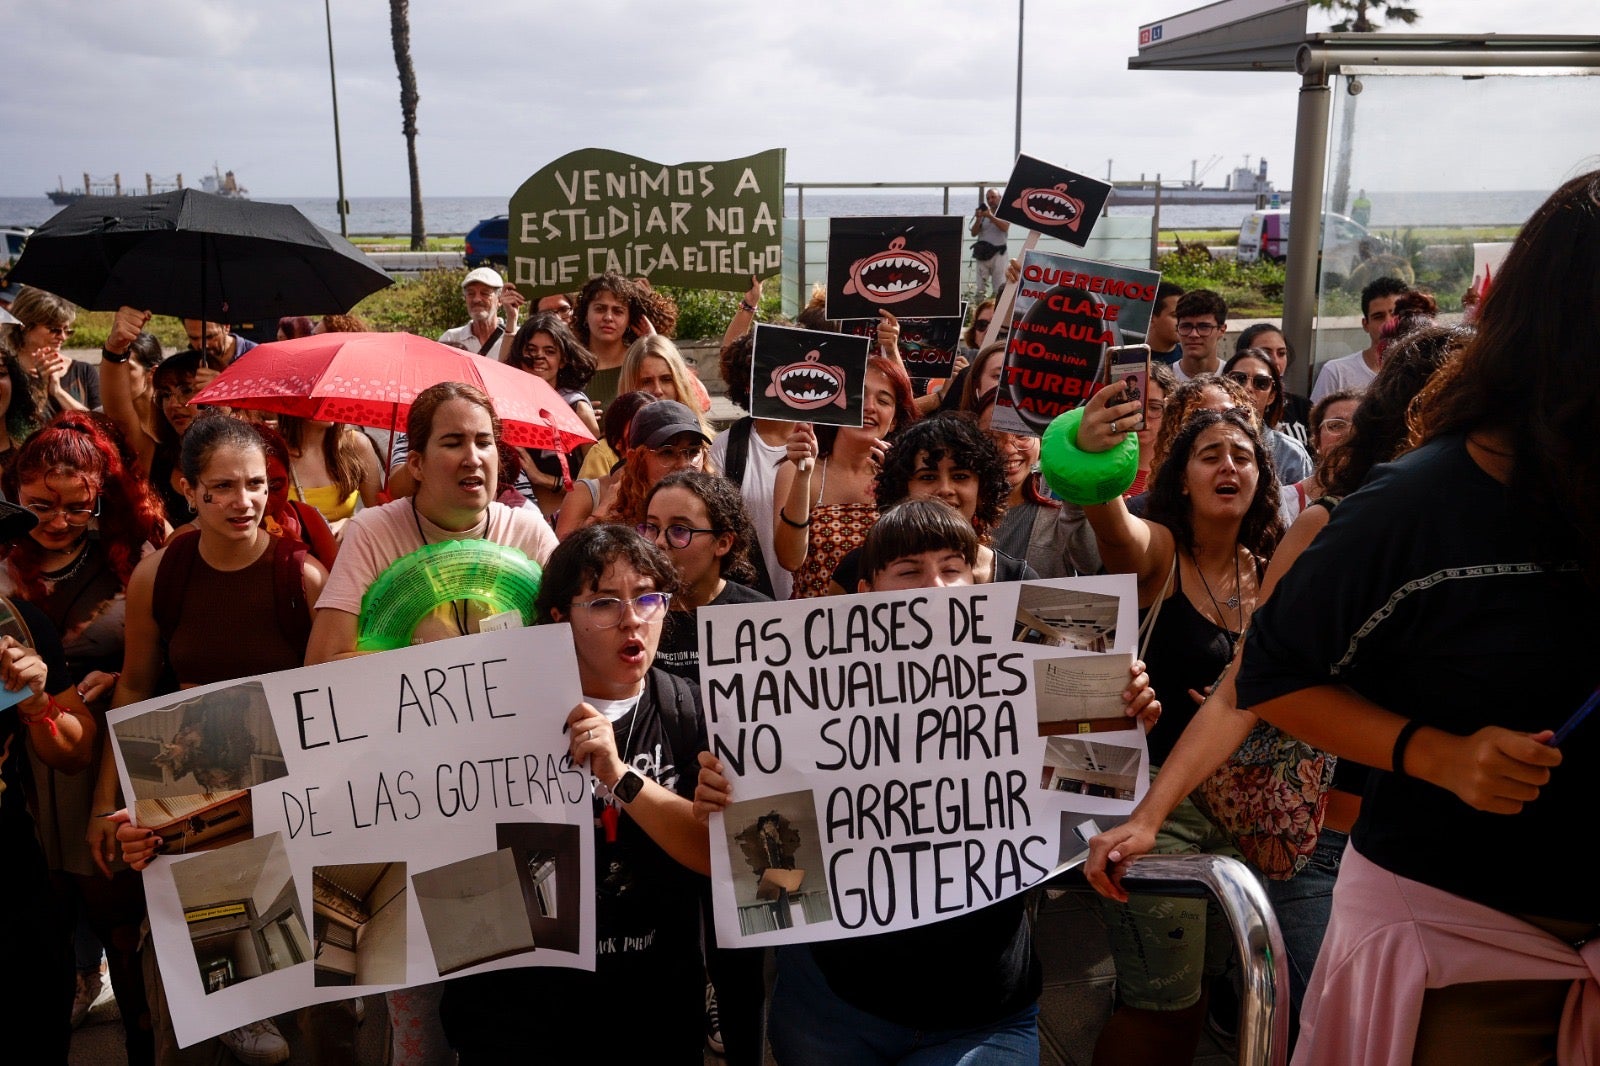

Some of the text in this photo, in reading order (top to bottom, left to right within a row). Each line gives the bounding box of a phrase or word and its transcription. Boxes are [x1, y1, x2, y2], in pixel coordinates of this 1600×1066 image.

[1153, 28, 1161, 39] L1
[734, 168, 760, 197] A
[706, 205, 746, 236] NO
[752, 202, 776, 236] A
[514, 254, 580, 288] QUE
[683, 246, 708, 272] EL
[700, 240, 780, 275] TECHO
[1023, 265, 1157, 302] QUEREMOS
[1021, 288, 1120, 322] DAR CLASE
[1013, 320, 1114, 346] EN UN AULA
[1009, 338, 1088, 367] NO EN UNA
[1005, 366, 1106, 400] TURBI
[705, 595, 992, 666] LAS CLASES DE
[656, 650, 688, 662] NNECTION
[293, 658, 516, 750] EL ARTE
[709, 652, 1027, 722] MANUALIDADES
[714, 724, 782, 776] NO
[816, 712, 900, 770] SON
[916, 700, 1019, 764] PARA
[282, 786, 332, 840] DE
[348, 770, 422, 829] LAS
[436, 752, 586, 818] GOTERAS
[826, 770, 1032, 844] ARREGLAR
[829, 835, 1048, 930] GOTERAS
[596, 937, 616, 954] ACK
